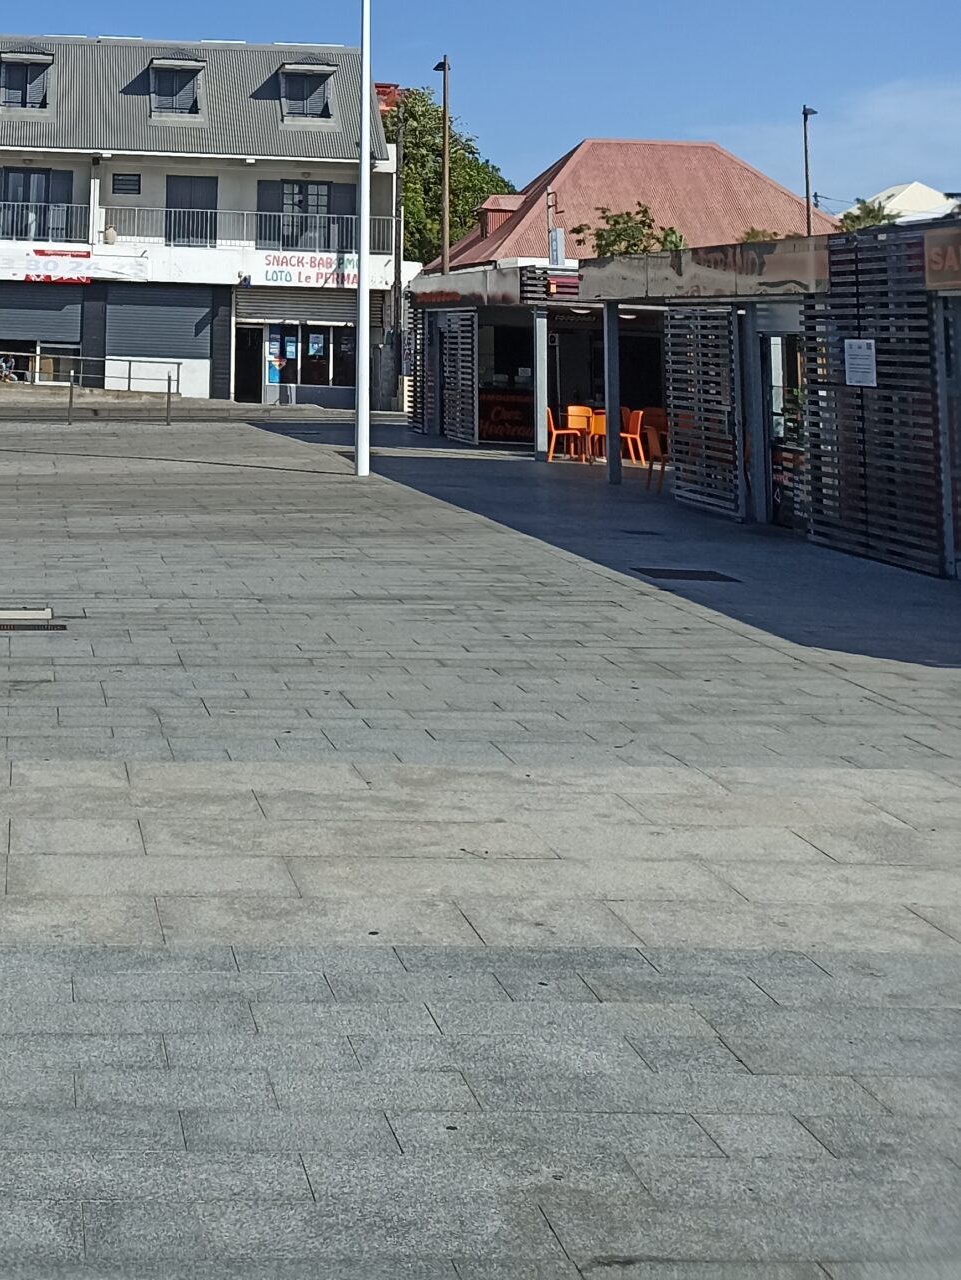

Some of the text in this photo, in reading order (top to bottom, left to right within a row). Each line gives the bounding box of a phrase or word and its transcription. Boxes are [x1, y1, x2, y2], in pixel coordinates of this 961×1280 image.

[337, 256, 359, 270] PM
[928, 246, 961, 271] SA
[265, 270, 292, 282] LOTO
[297, 271, 312, 284] Le
